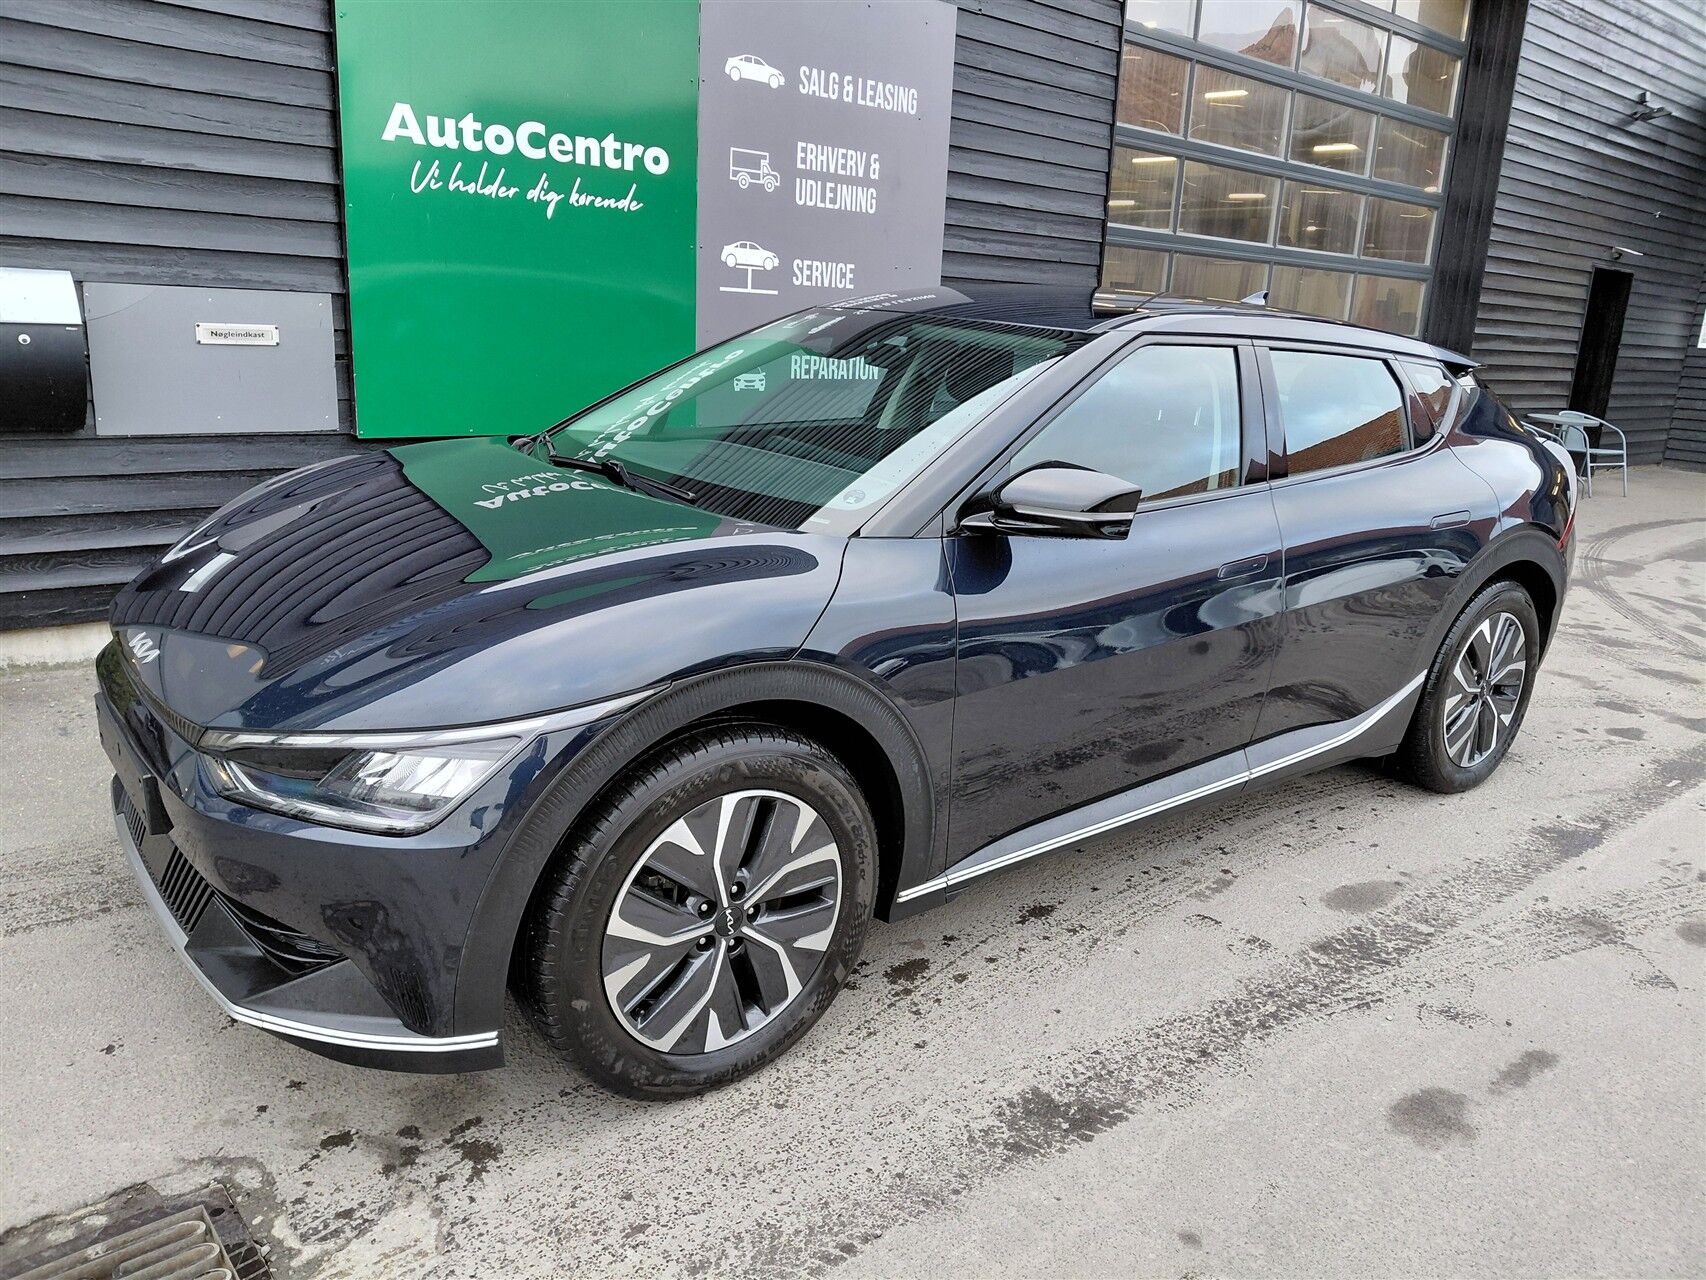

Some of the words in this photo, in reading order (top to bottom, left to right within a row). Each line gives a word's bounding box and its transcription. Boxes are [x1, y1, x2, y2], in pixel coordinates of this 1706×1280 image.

[799, 65, 839, 100] SALG
[842, 75, 854, 103] &
[857, 78, 918, 115] LEASING
[380, 101, 670, 175] AutoCentro
[796, 141, 867, 178] ERHVERV
[869, 153, 880, 180] &
[410, 160, 443, 194] Vi
[448, 160, 520, 199] holder
[526, 172, 565, 220] dig
[795, 178, 877, 214] UDLEJNING
[792, 258, 855, 289] SERVICE
[210, 330, 265, 339] Nøgleindkast
[790, 354, 879, 380] REPARATION
